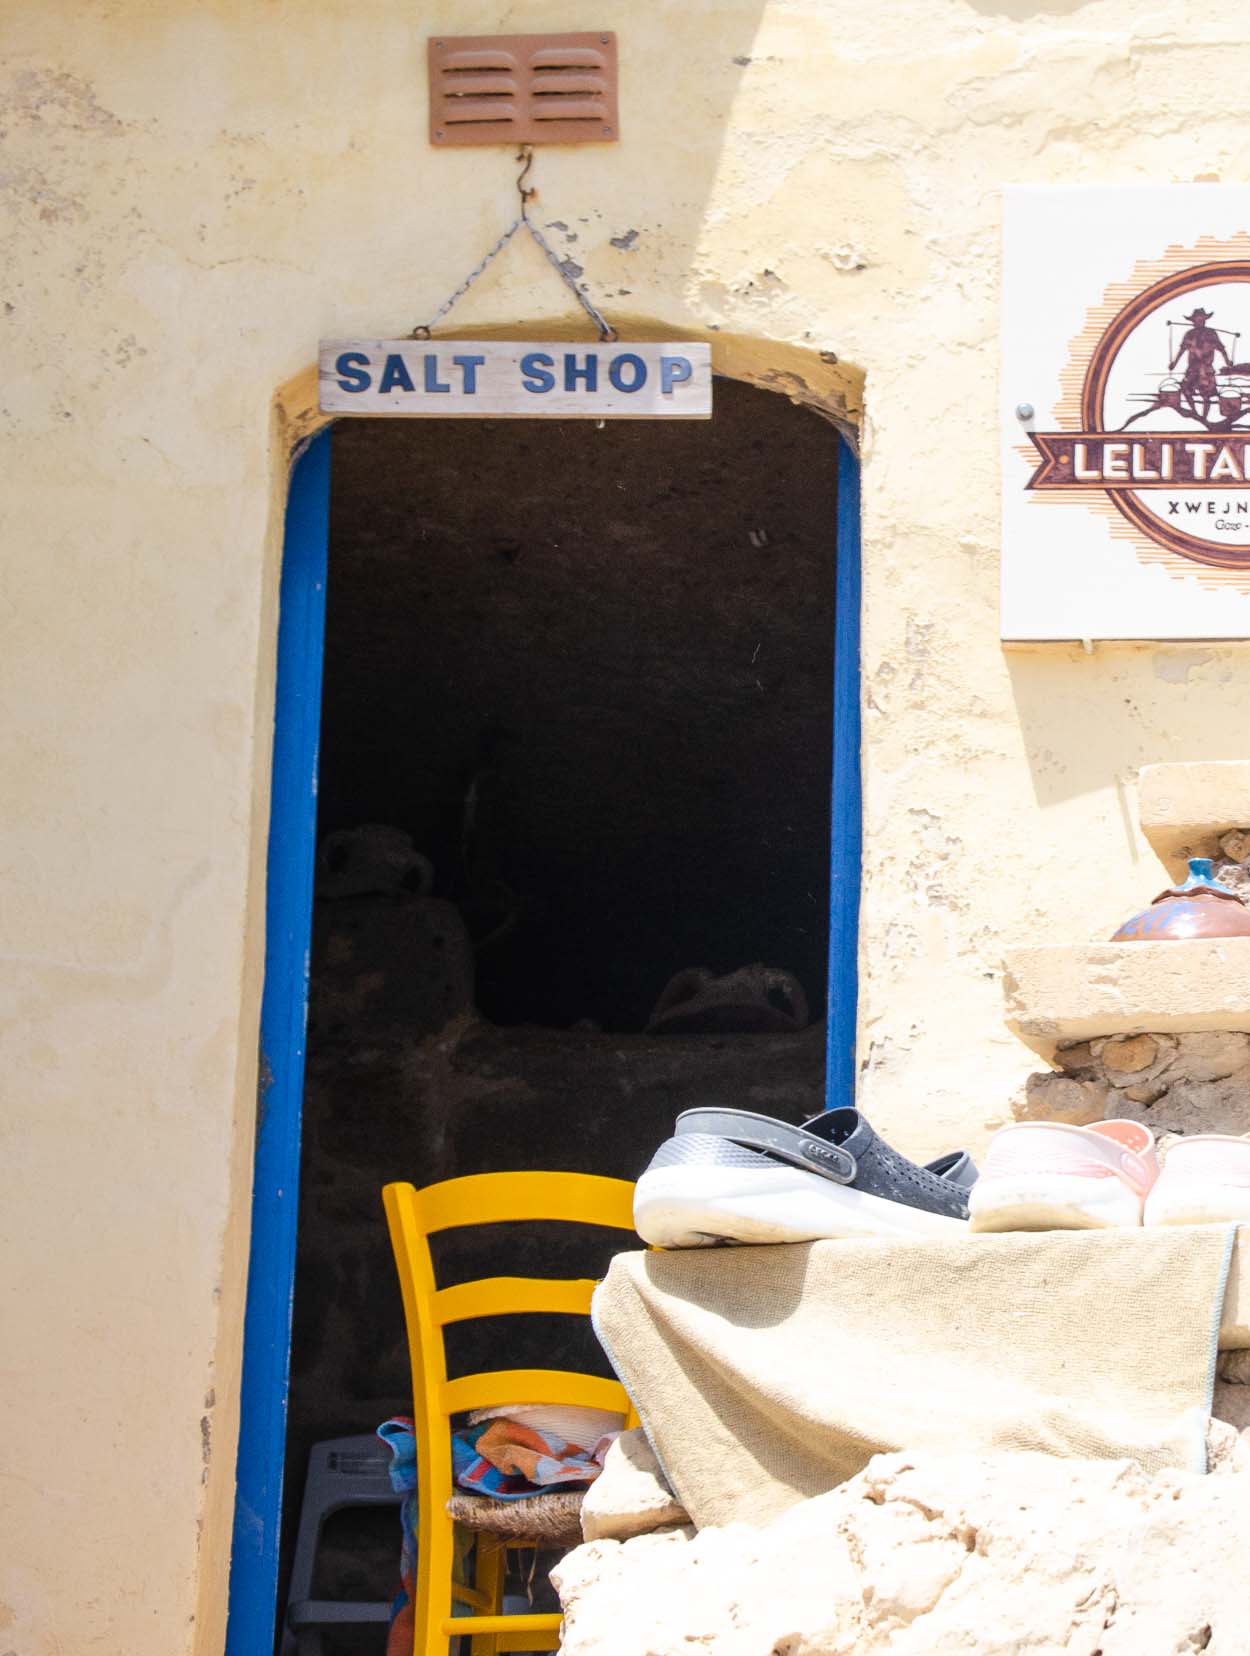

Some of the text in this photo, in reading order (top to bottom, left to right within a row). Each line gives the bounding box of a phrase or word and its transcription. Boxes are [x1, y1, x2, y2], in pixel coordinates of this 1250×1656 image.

[335, 352, 693, 394] SALT SHOP
[1073, 443, 1173, 481] LELI
